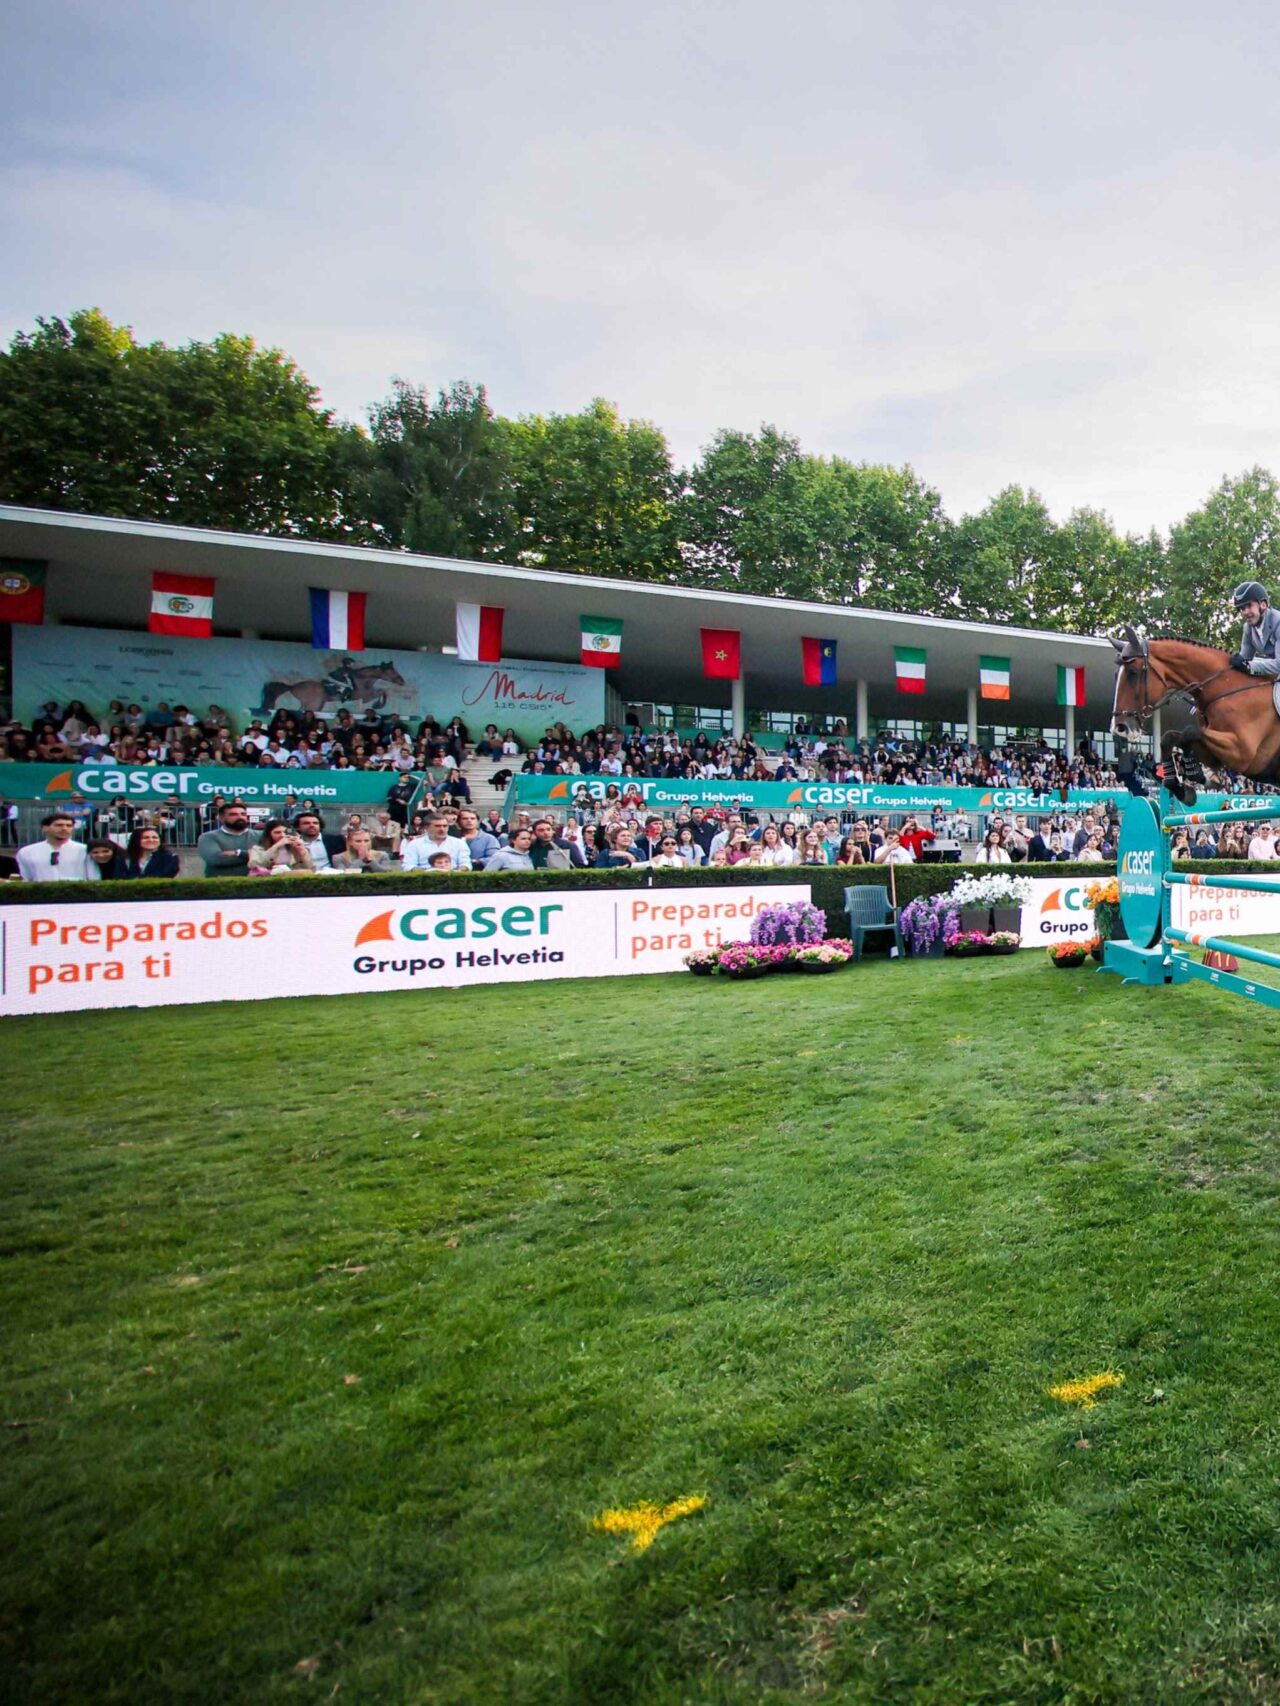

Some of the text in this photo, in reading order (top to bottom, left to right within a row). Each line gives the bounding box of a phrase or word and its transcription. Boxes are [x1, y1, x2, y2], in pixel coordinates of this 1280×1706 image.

[462, 671, 575, 705] Madrid
[494, 701, 516, 709] 115
[77, 770, 337, 799] caser Grupo Helvetia
[656, 790, 699, 802] Grupo
[702, 792, 754, 802] Helvetia
[805, 787, 953, 807] caser Grupo Helvetia
[1048, 800, 1077, 809] Grupo
[1127, 850, 1155, 875] caser
[400, 904, 563, 941] caser
[1039, 920, 1088, 936] Grupo
[1189, 905, 1241, 927] para ti
[30, 911, 268, 952] Preparados
[631, 927, 722, 960] para ti
[29, 952, 171, 994] para ti
[353, 946, 564, 976] Grupo Helvetia
